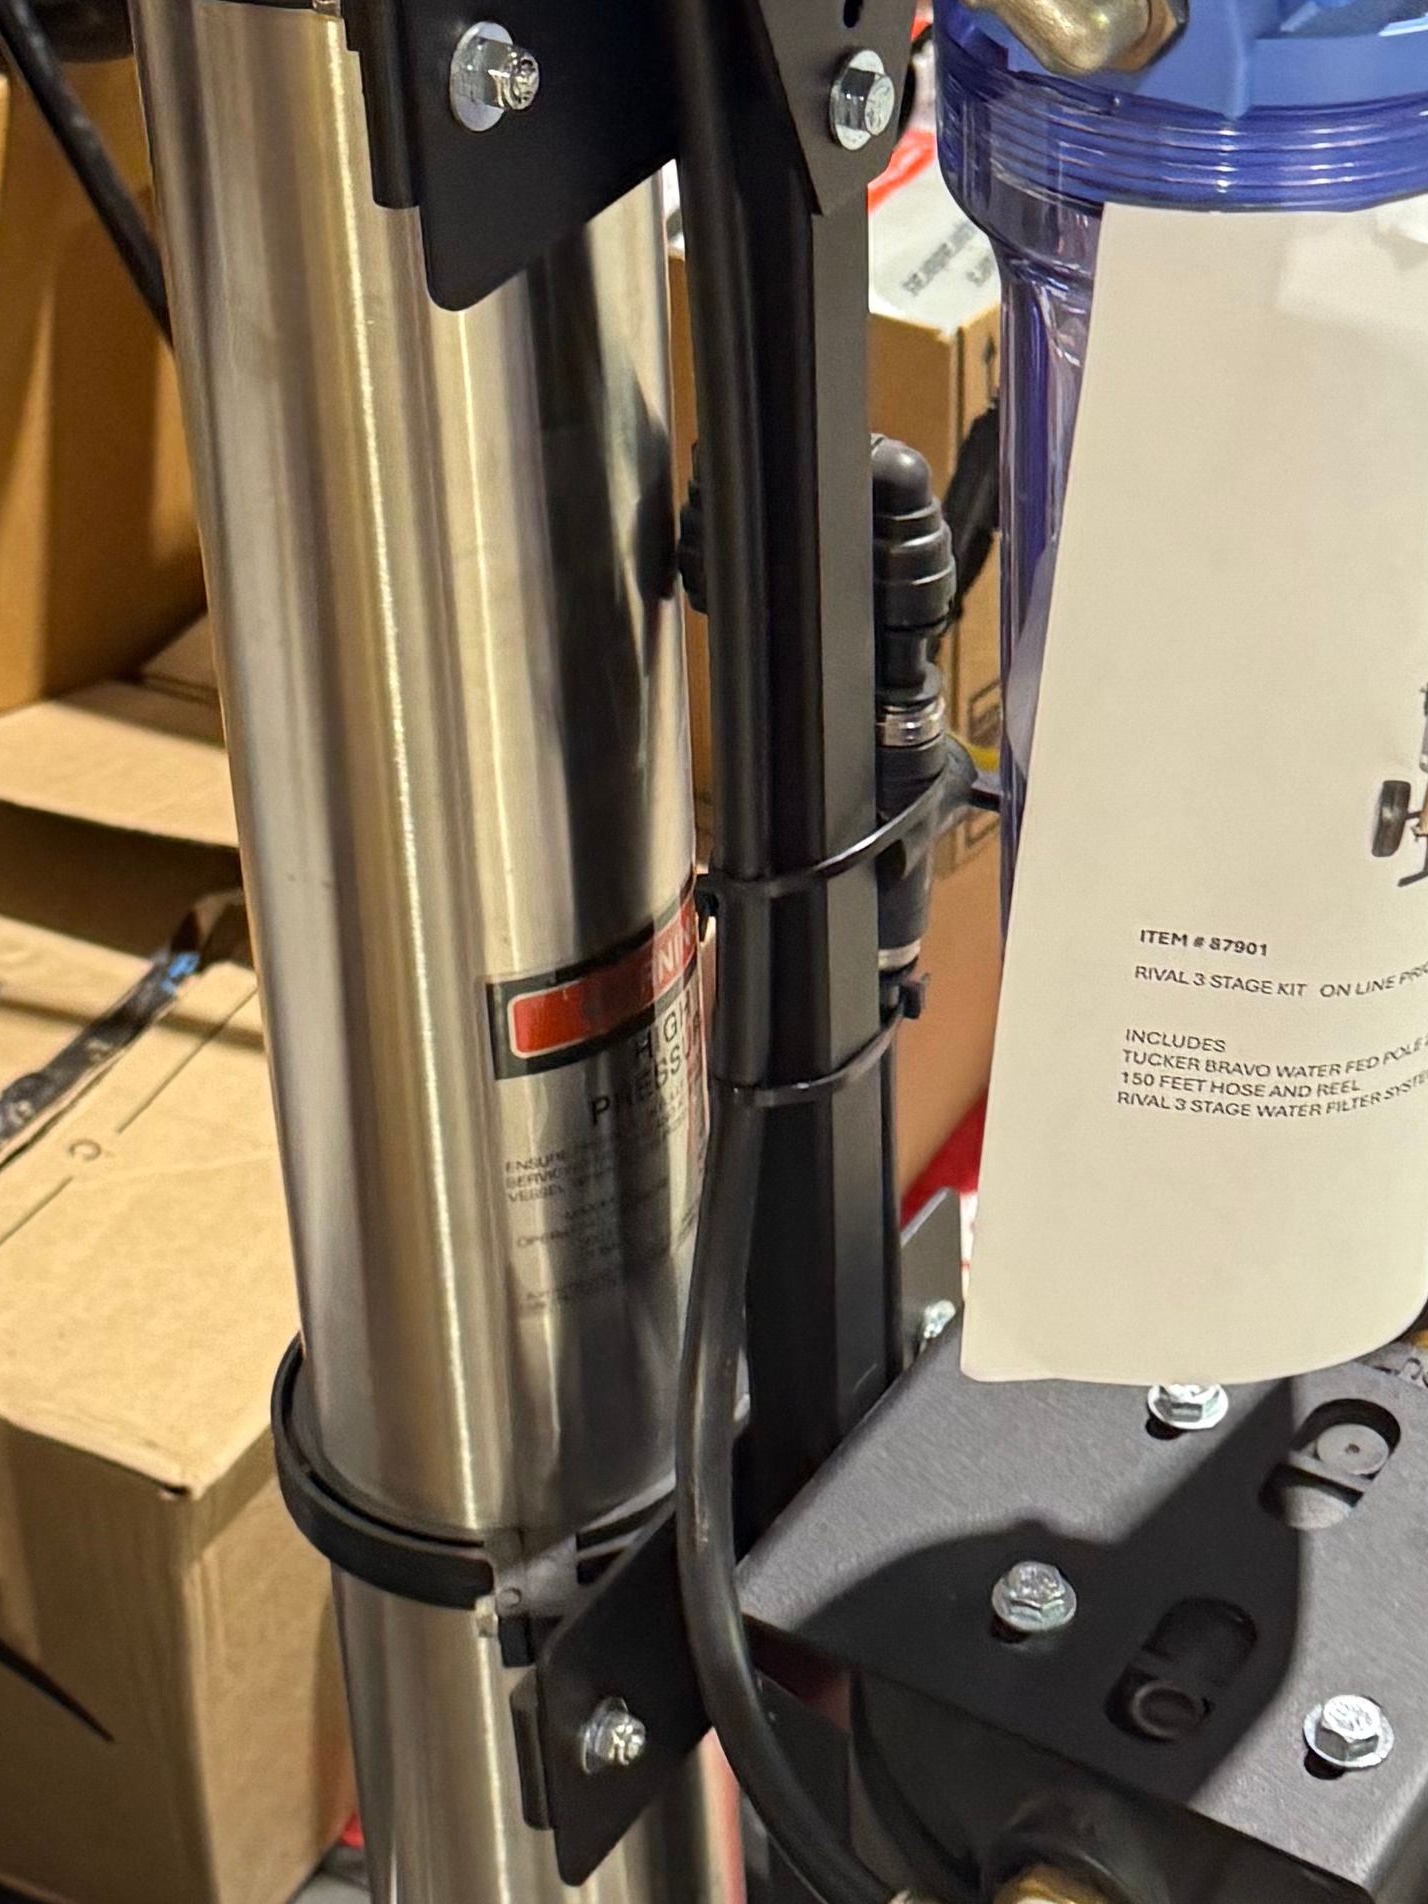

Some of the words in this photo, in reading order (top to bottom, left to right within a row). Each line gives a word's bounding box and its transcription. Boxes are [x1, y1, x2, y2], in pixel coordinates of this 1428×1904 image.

[1140, 929, 1188, 947] ITEM
[1193, 936, 1205, 947] #
[1209, 937, 1267, 956] 87901
[1135, 965, 1189, 985] RIVAL
[1193, 973, 1206, 986] 3
[1210, 974, 1273, 995] STAGE
[1277, 982, 1307, 997] KIT
[1320, 983, 1351, 997] ON
[1355, 975, 1396, 995] LINE
[1125, 1028, 1226, 1053] INCLUDES
[1122, 1049, 1200, 1072] TUCKER
[1205, 1059, 1270, 1078] BRAVO
[1276, 1063, 1341, 1079] WATER
[1346, 1056, 1379, 1074] FED
[1121, 1072, 1154, 1086] 150
[1159, 1075, 1207, 1092] FEET
[1211, 1081, 1266, 1097] HOSE
[1268, 1083, 1312, 1098] AND
[1317, 1080, 1360, 1097] REEL
[1117, 1091, 1170, 1110] RIVAL
[1175, 1098, 1186, 1111] 3
[1190, 1099, 1251, 1117] STAGE
[1256, 1102, 1322, 1118] WATER
[1326, 1091, 1381, 1115] FILTER
